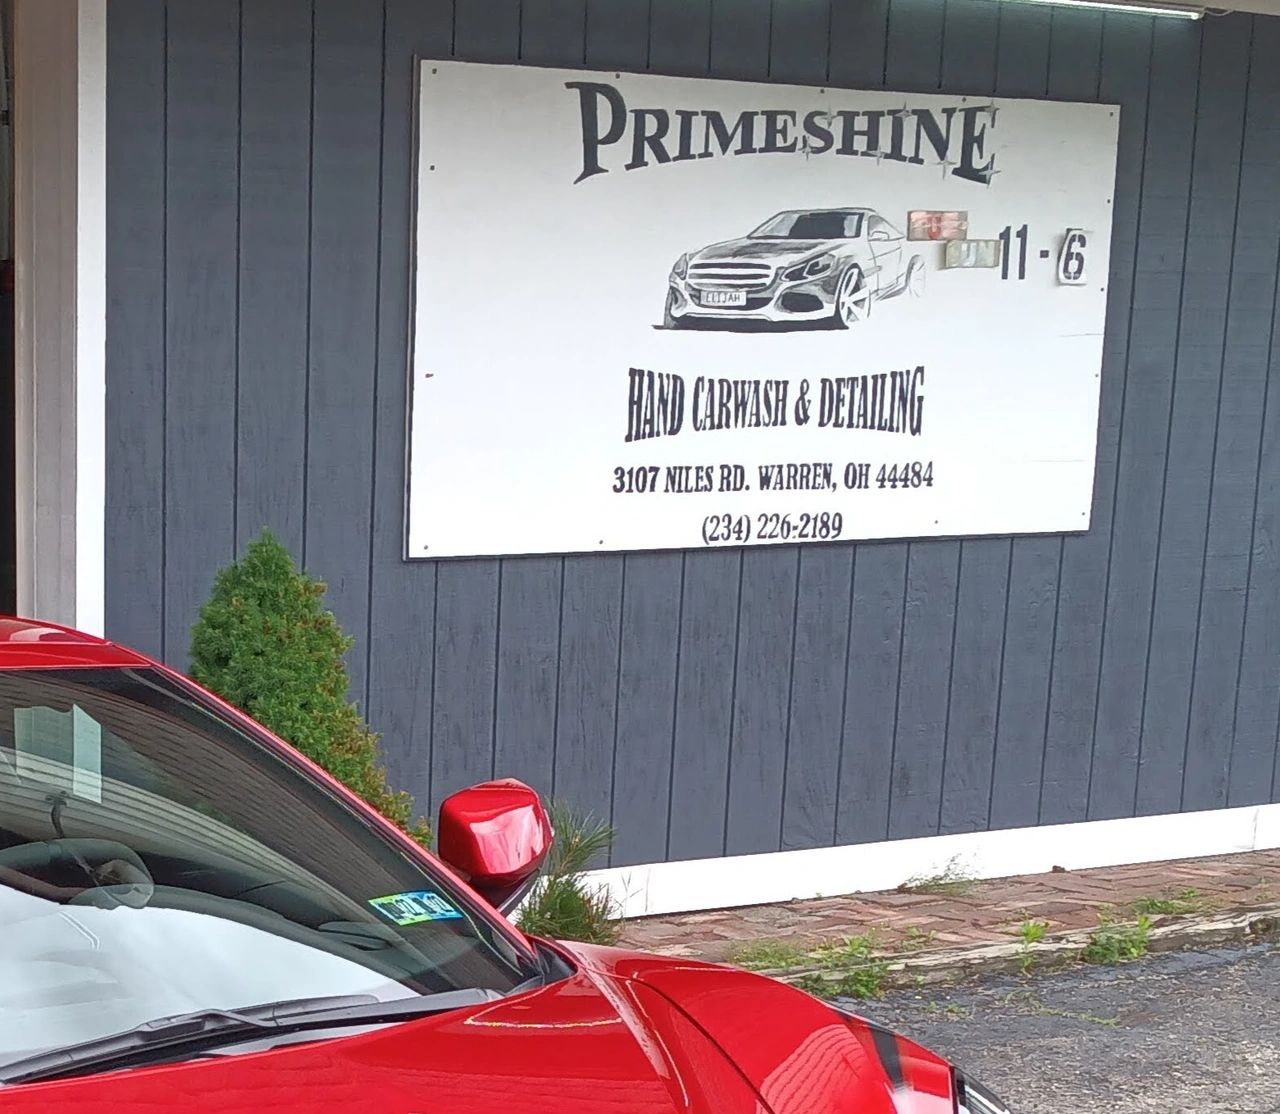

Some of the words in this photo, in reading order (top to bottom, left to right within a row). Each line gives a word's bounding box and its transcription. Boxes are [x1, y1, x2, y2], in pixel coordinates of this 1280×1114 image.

[564, 80, 1001, 186] PRIMESHINE
[999, 224, 1028, 280] 11
[1062, 233, 1087, 281] 6
[624, 367, 685, 443] HAND
[692, 376, 789, 432] CARWASH
[794, 378, 811, 426] &
[817, 366, 925, 437] DETAILING
[612, 466, 661, 493] 3107
[663, 465, 714, 494] NILES
[718, 464, 750, 493] RD.
[758, 462, 837, 492] WARREN,
[844, 462, 871, 490] OH
[875, 461, 934, 489] 44484
[702, 513, 751, 545] (234)
[757, 511, 843, 540] 226-2189
